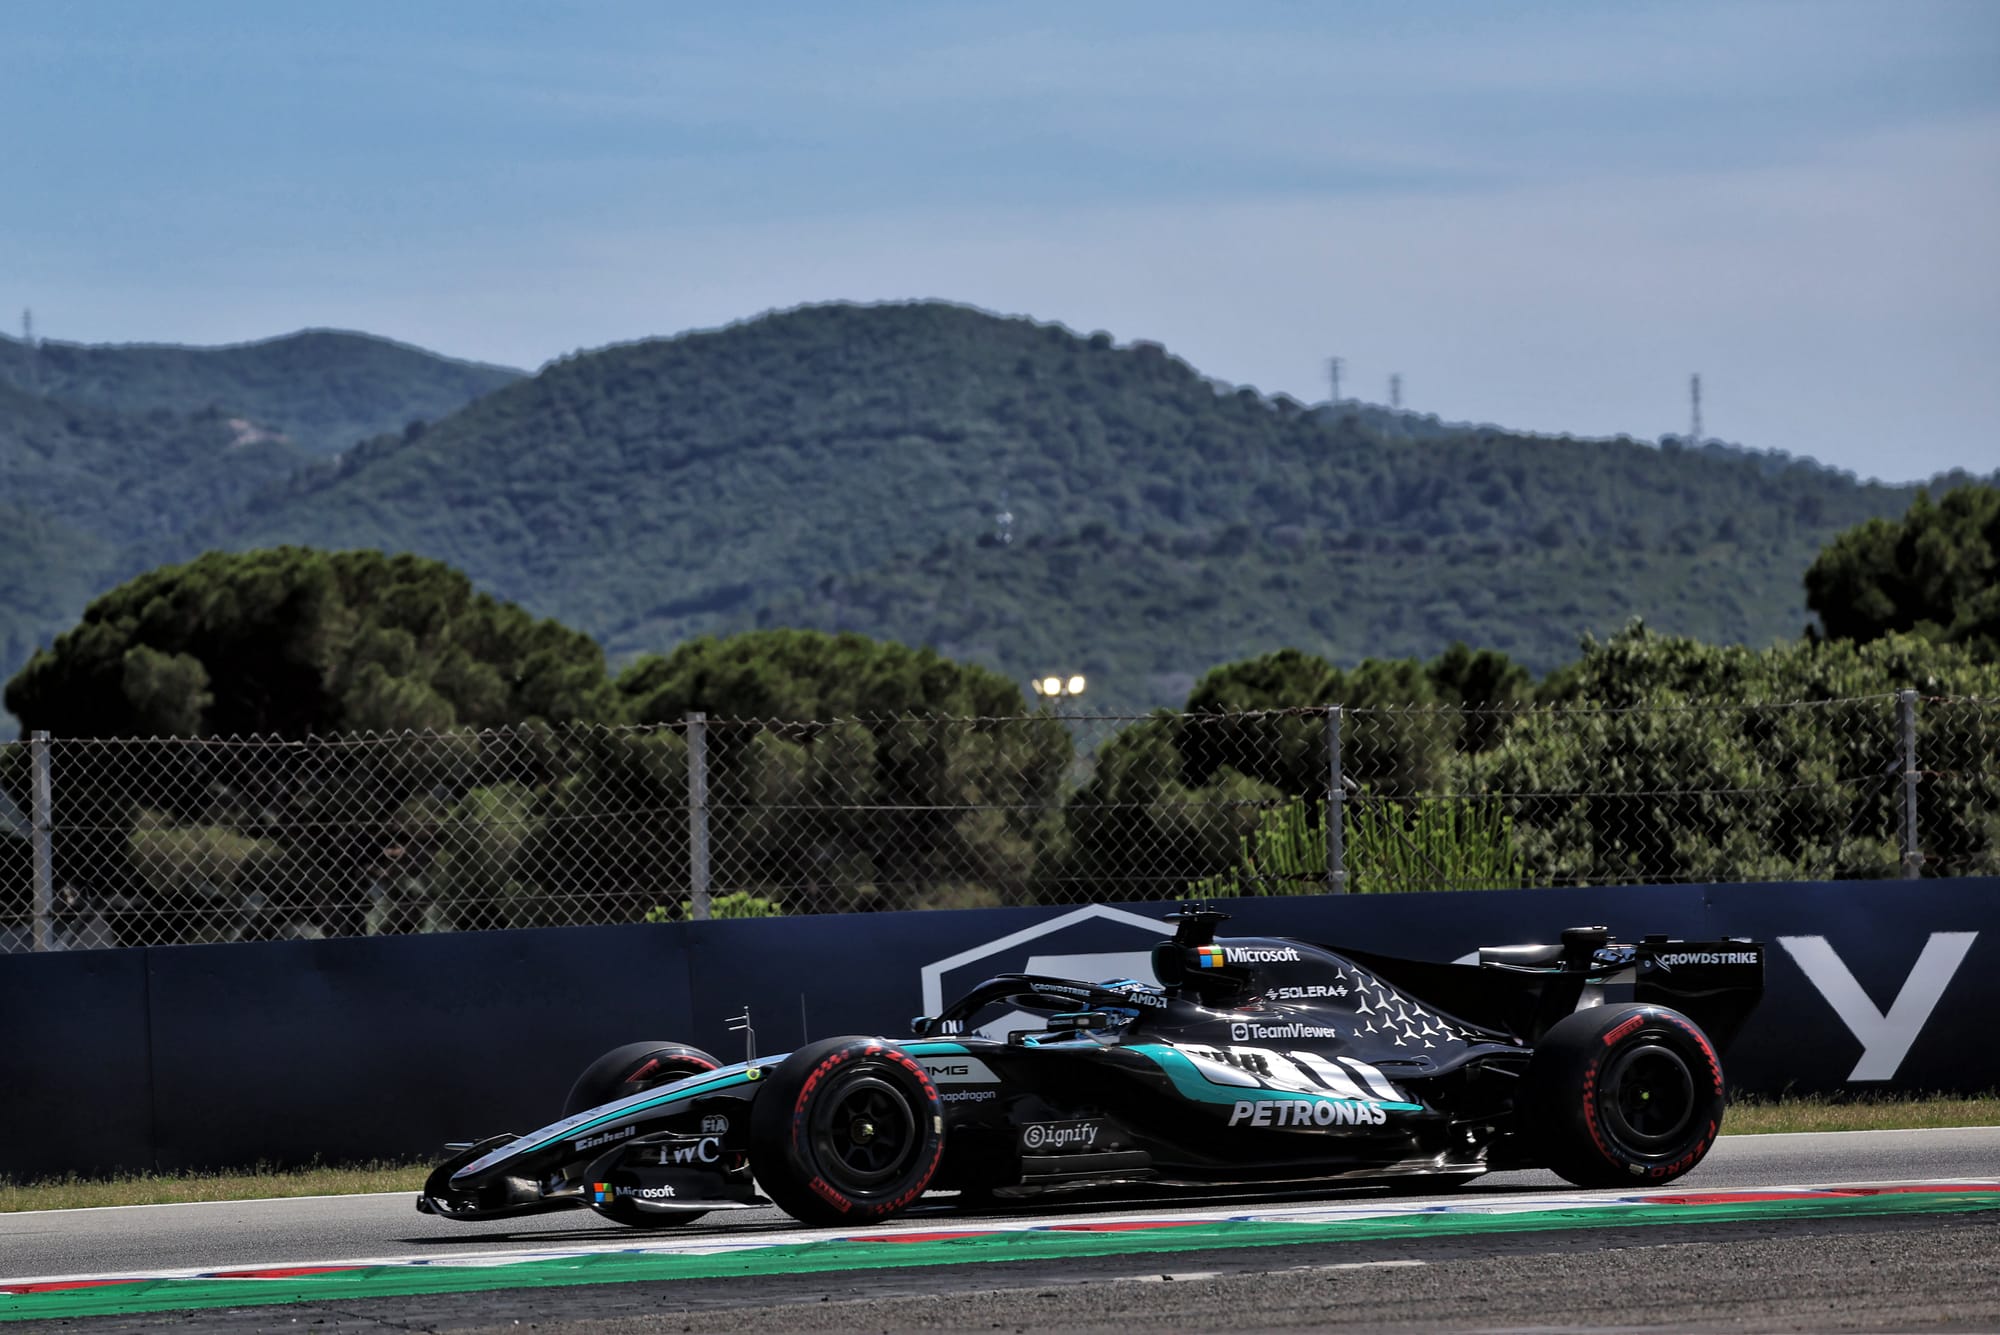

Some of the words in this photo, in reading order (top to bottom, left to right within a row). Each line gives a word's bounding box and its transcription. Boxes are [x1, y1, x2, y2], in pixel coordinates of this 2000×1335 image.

[1225, 946, 1301, 965] Microsoft
[1661, 951, 1759, 966] CROWDSTRIKE
[1035, 983, 1092, 998] CROWDSTRIKE
[1279, 985, 1338, 1000] SOLERA
[1128, 991, 1158, 1007] AMD
[941, 1018, 965, 1034] nu
[1248, 1022, 1336, 1040] TeamViewer
[940, 1088, 996, 1104] napdragon
[1227, 1100, 1388, 1127] PETRONAS
[701, 1115, 729, 1134] FIA
[574, 1124, 636, 1153] Einhell
[615, 1183, 676, 1200] Microsoft
